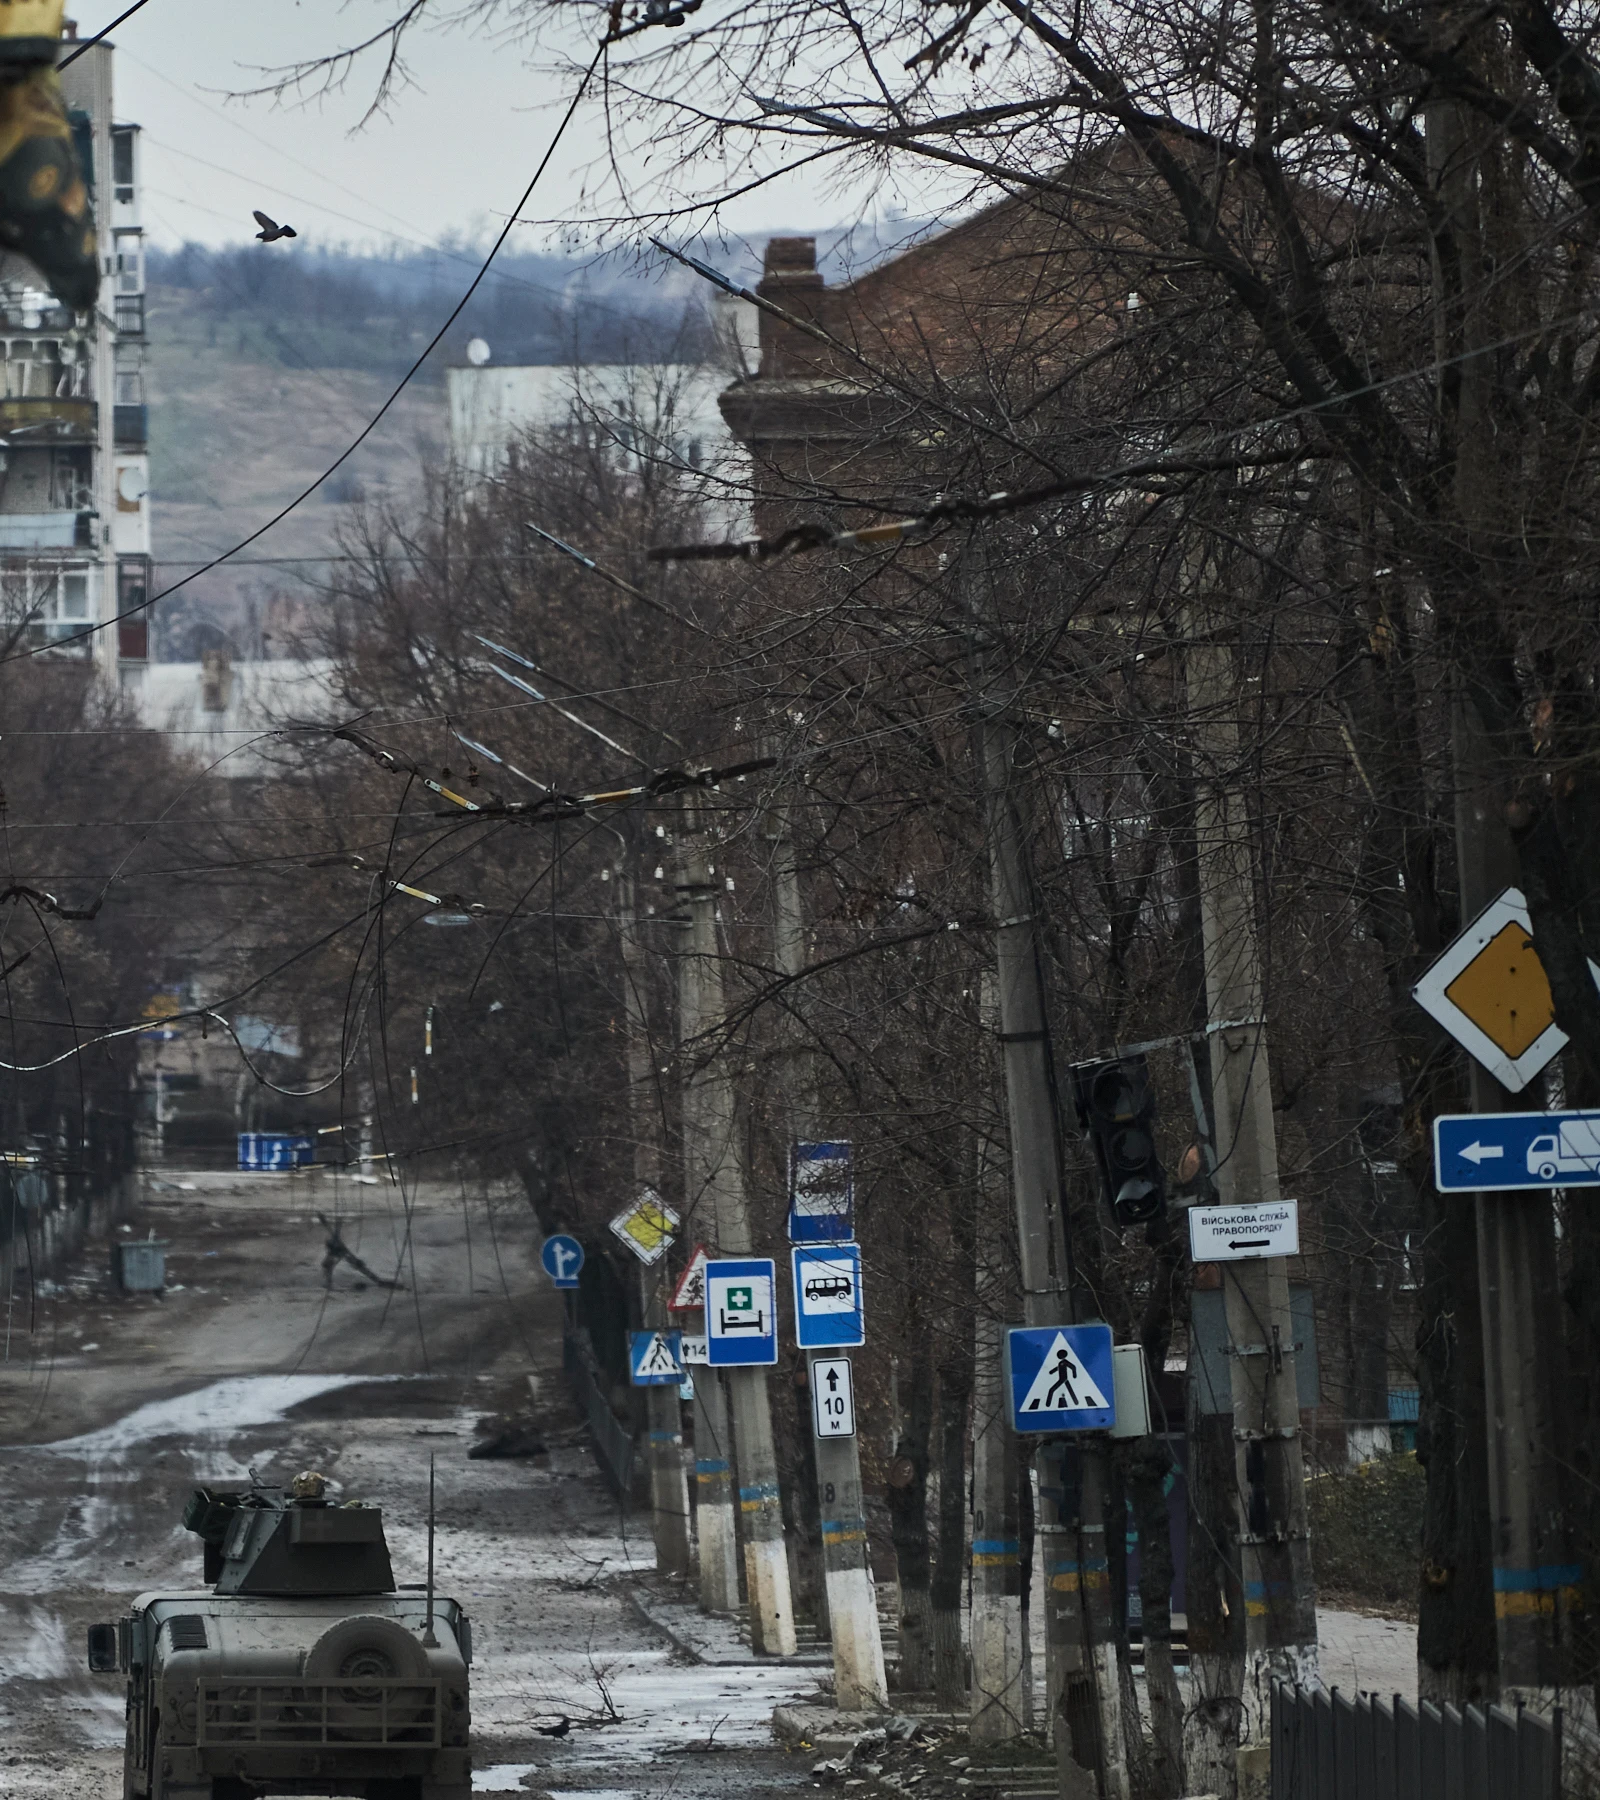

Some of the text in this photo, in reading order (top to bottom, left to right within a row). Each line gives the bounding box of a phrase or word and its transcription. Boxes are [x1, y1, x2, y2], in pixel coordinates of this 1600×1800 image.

[1201, 1212, 1290, 1226] ВІЙСЬКОВА СЛУЖБА
[1212, 1223, 1283, 1236] ПРАВОПОРЯДКУ
[824, 1396, 845, 1416] 10
